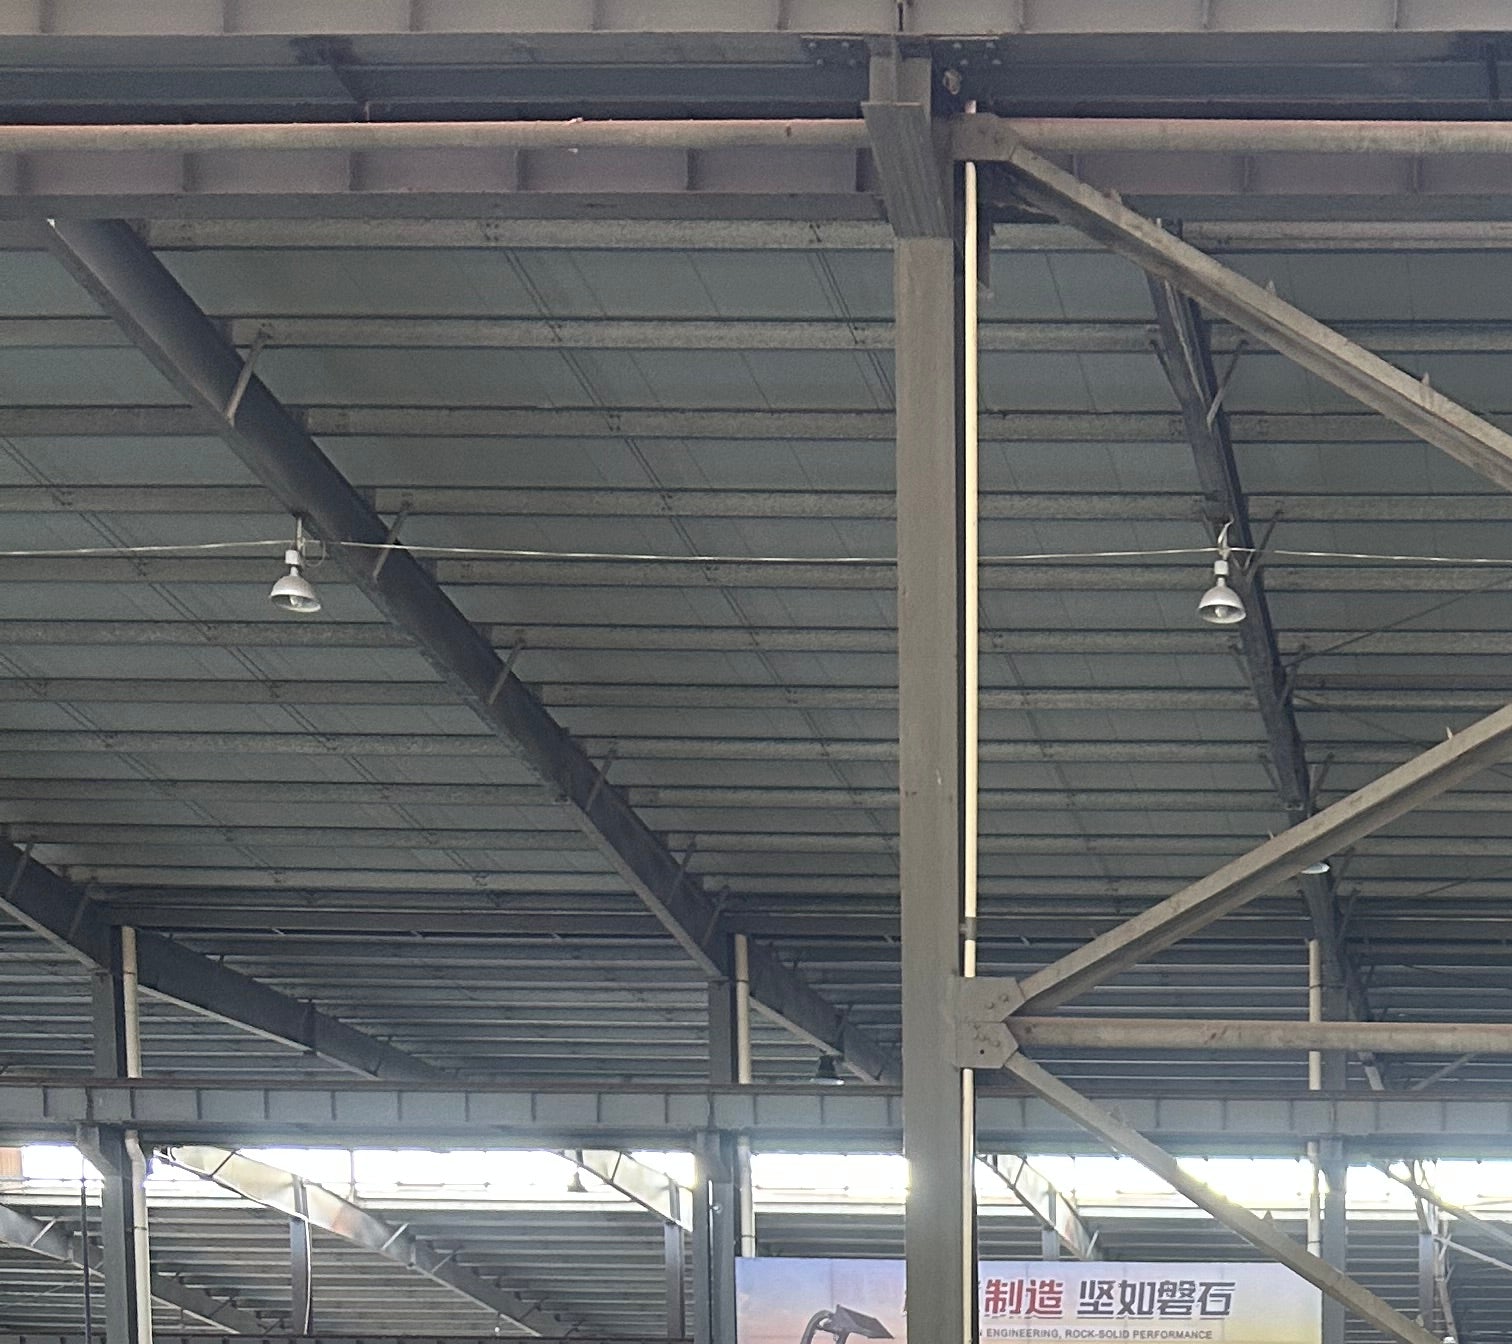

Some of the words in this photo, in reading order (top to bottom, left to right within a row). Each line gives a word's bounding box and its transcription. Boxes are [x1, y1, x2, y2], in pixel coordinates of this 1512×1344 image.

[978, 1279, 1065, 1316] 制造
[1077, 1279, 1236, 1317] 坚如磐石
[986, 1328, 1062, 1339] ENGINEERING,
[1065, 1329, 1130, 1338] ROCK-SOLID
[1133, 1330, 1213, 1340] PERFORMANCE
